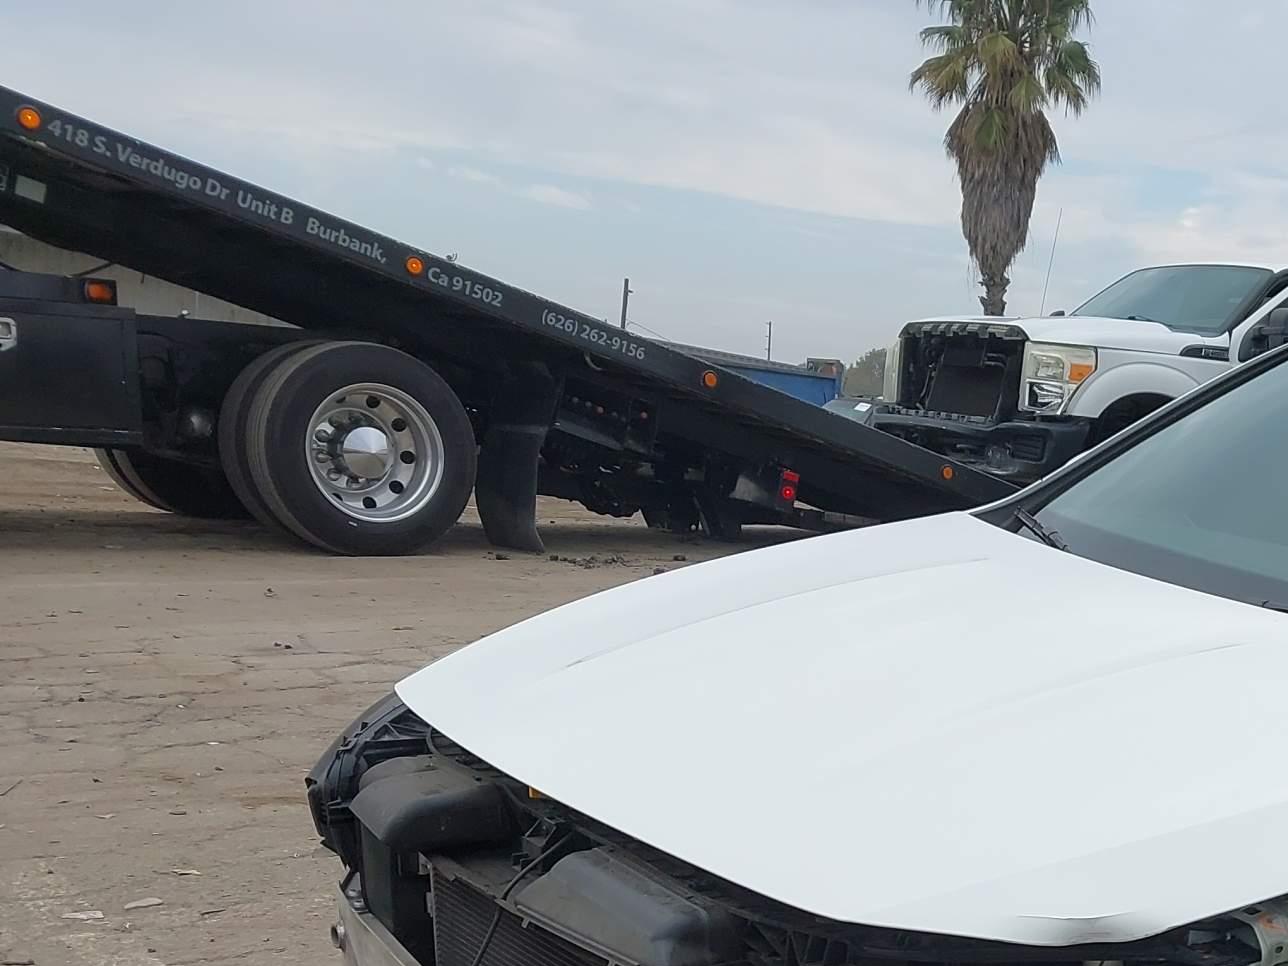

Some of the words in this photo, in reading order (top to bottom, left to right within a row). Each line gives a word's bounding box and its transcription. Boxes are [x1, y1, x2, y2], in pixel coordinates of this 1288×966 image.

[48, 119, 89, 147] 418
[93, 135, 111, 157] S.
[116, 143, 202, 189] Verdugo
[205, 178, 230, 200] Dr
[236, 190, 278, 220] Unit
[280, 207, 294, 225] B
[306, 217, 387, 264] Burbank,
[428, 267, 448, 287] Ca
[452, 276, 504, 307] 91502
[541, 309, 579, 336] (626)
[580, 324, 647, 361] 262-9156
